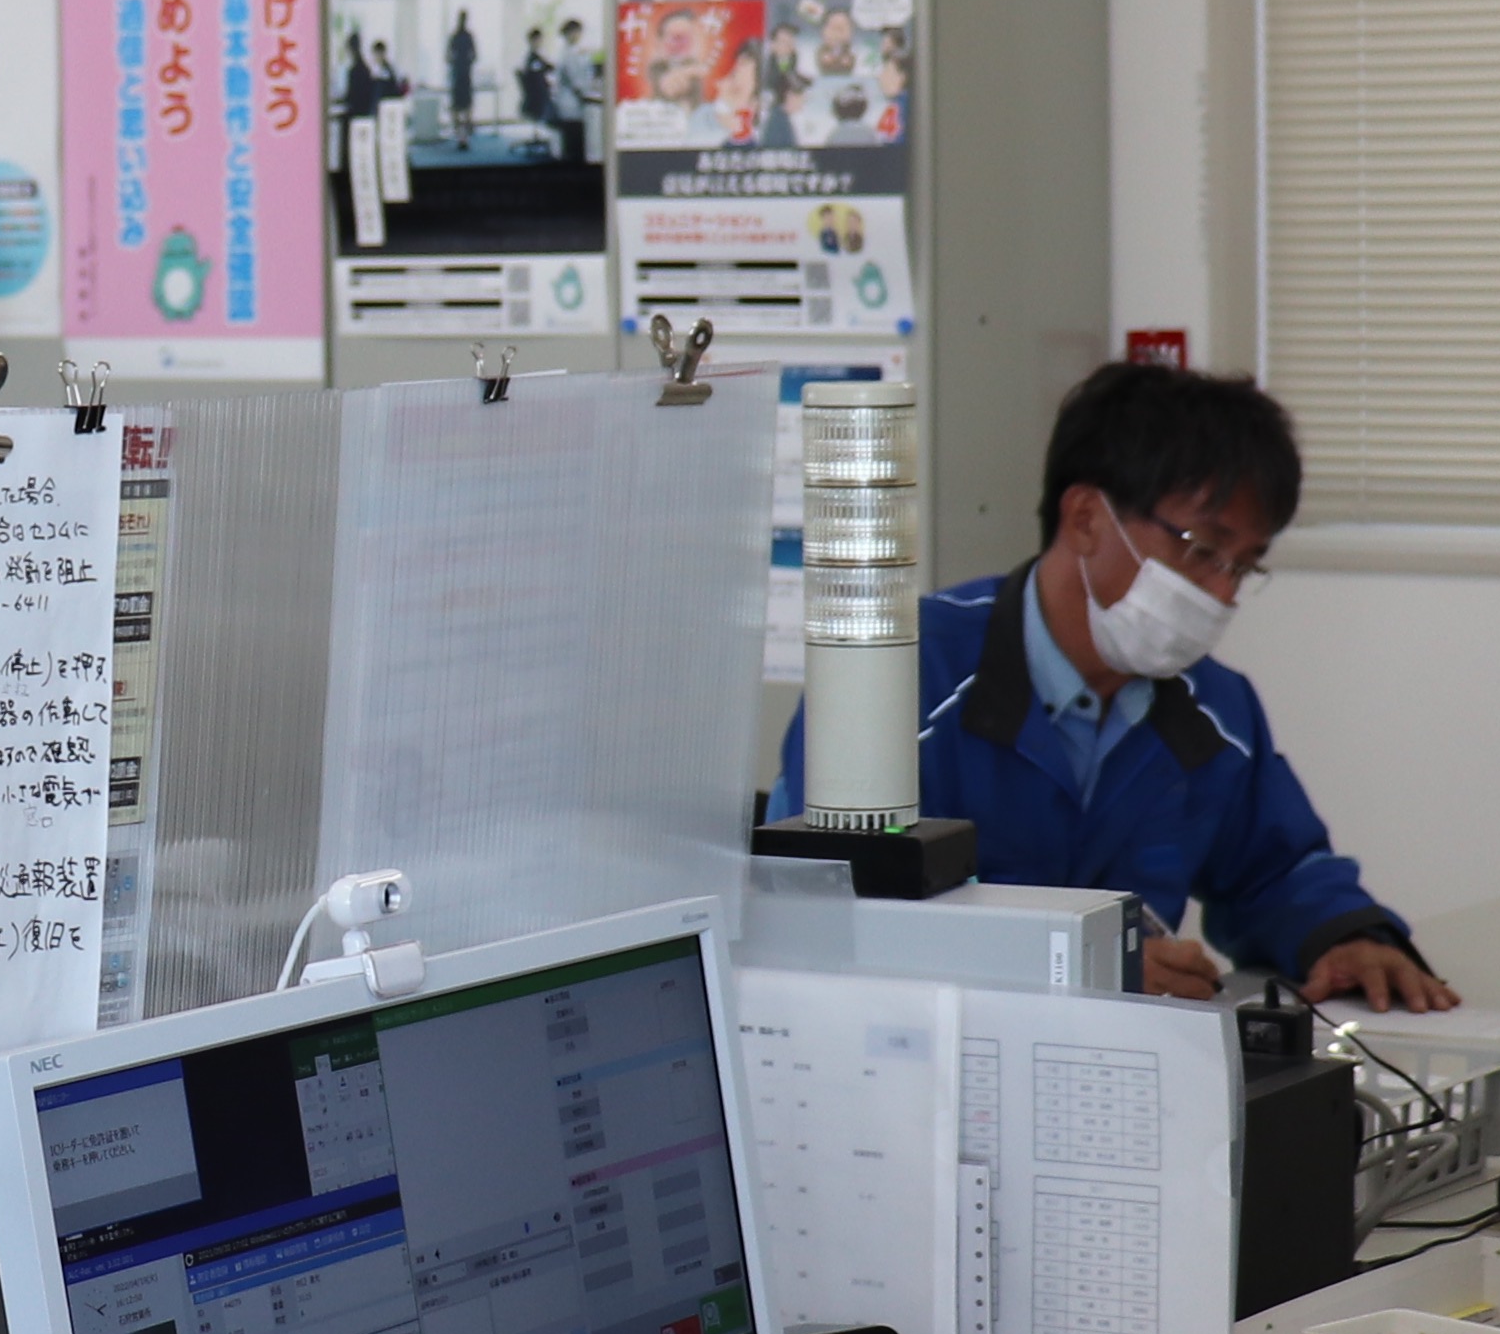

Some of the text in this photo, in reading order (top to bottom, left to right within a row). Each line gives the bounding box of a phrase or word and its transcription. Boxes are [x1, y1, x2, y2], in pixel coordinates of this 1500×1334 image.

[733, 108, 754, 141] 3
[876, 104, 900, 136] 4
[30, 1054, 64, 1074] NEC
